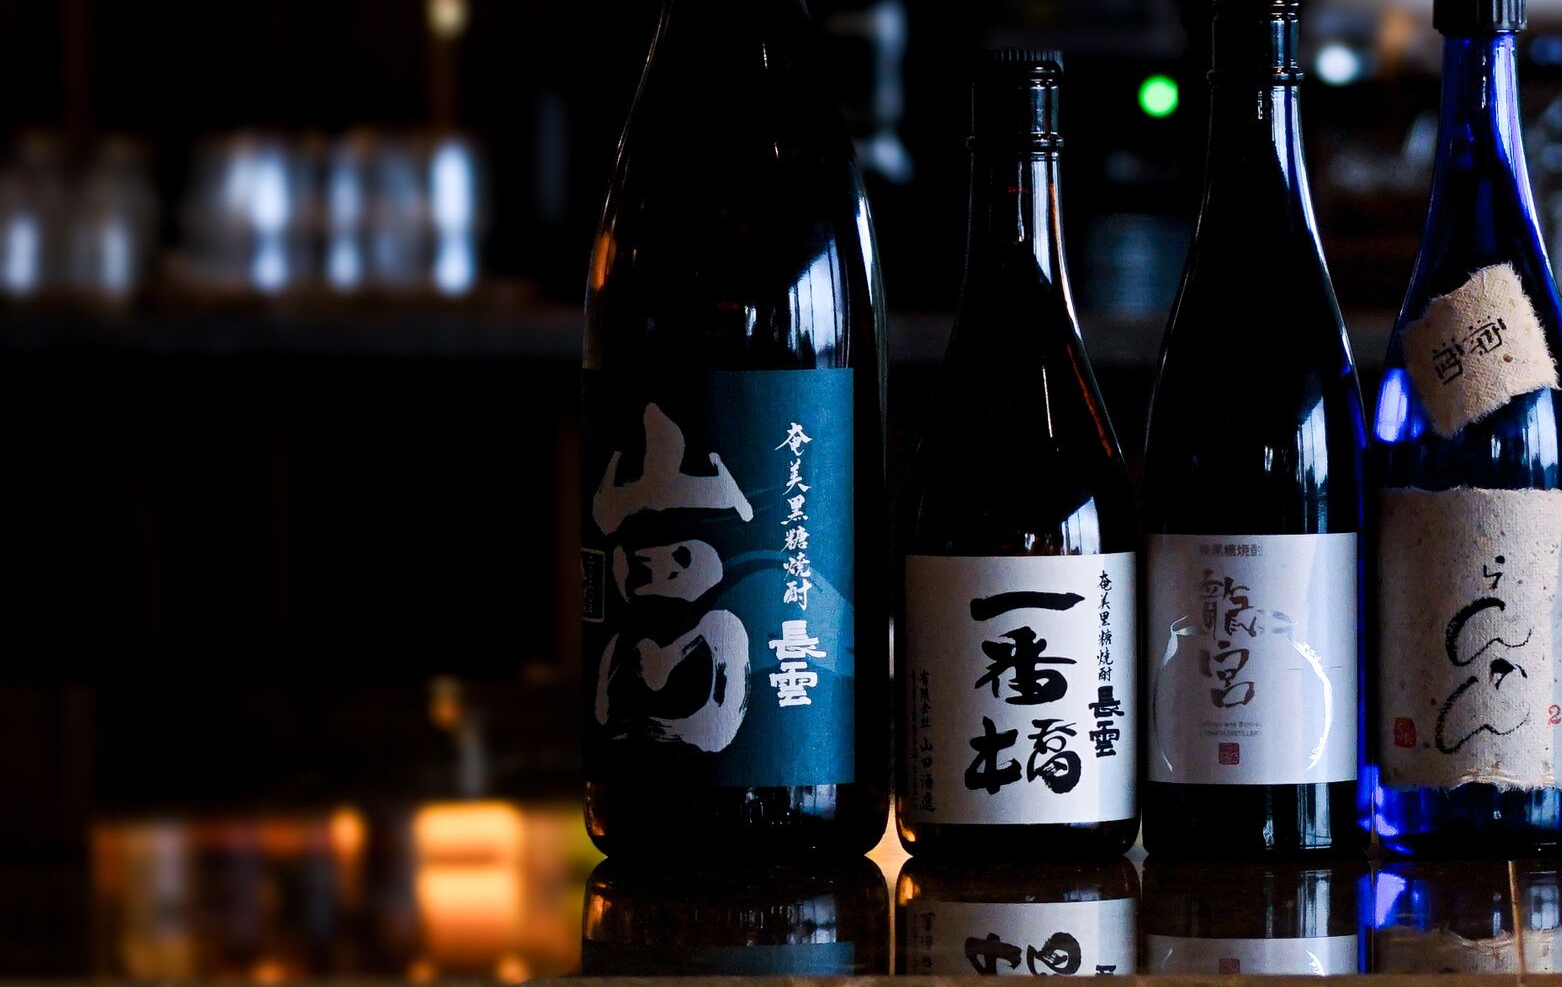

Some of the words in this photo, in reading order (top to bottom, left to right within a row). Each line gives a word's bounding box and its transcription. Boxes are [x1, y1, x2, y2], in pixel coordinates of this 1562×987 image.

[775, 422, 812, 611] 奄美黒糖焼酎
